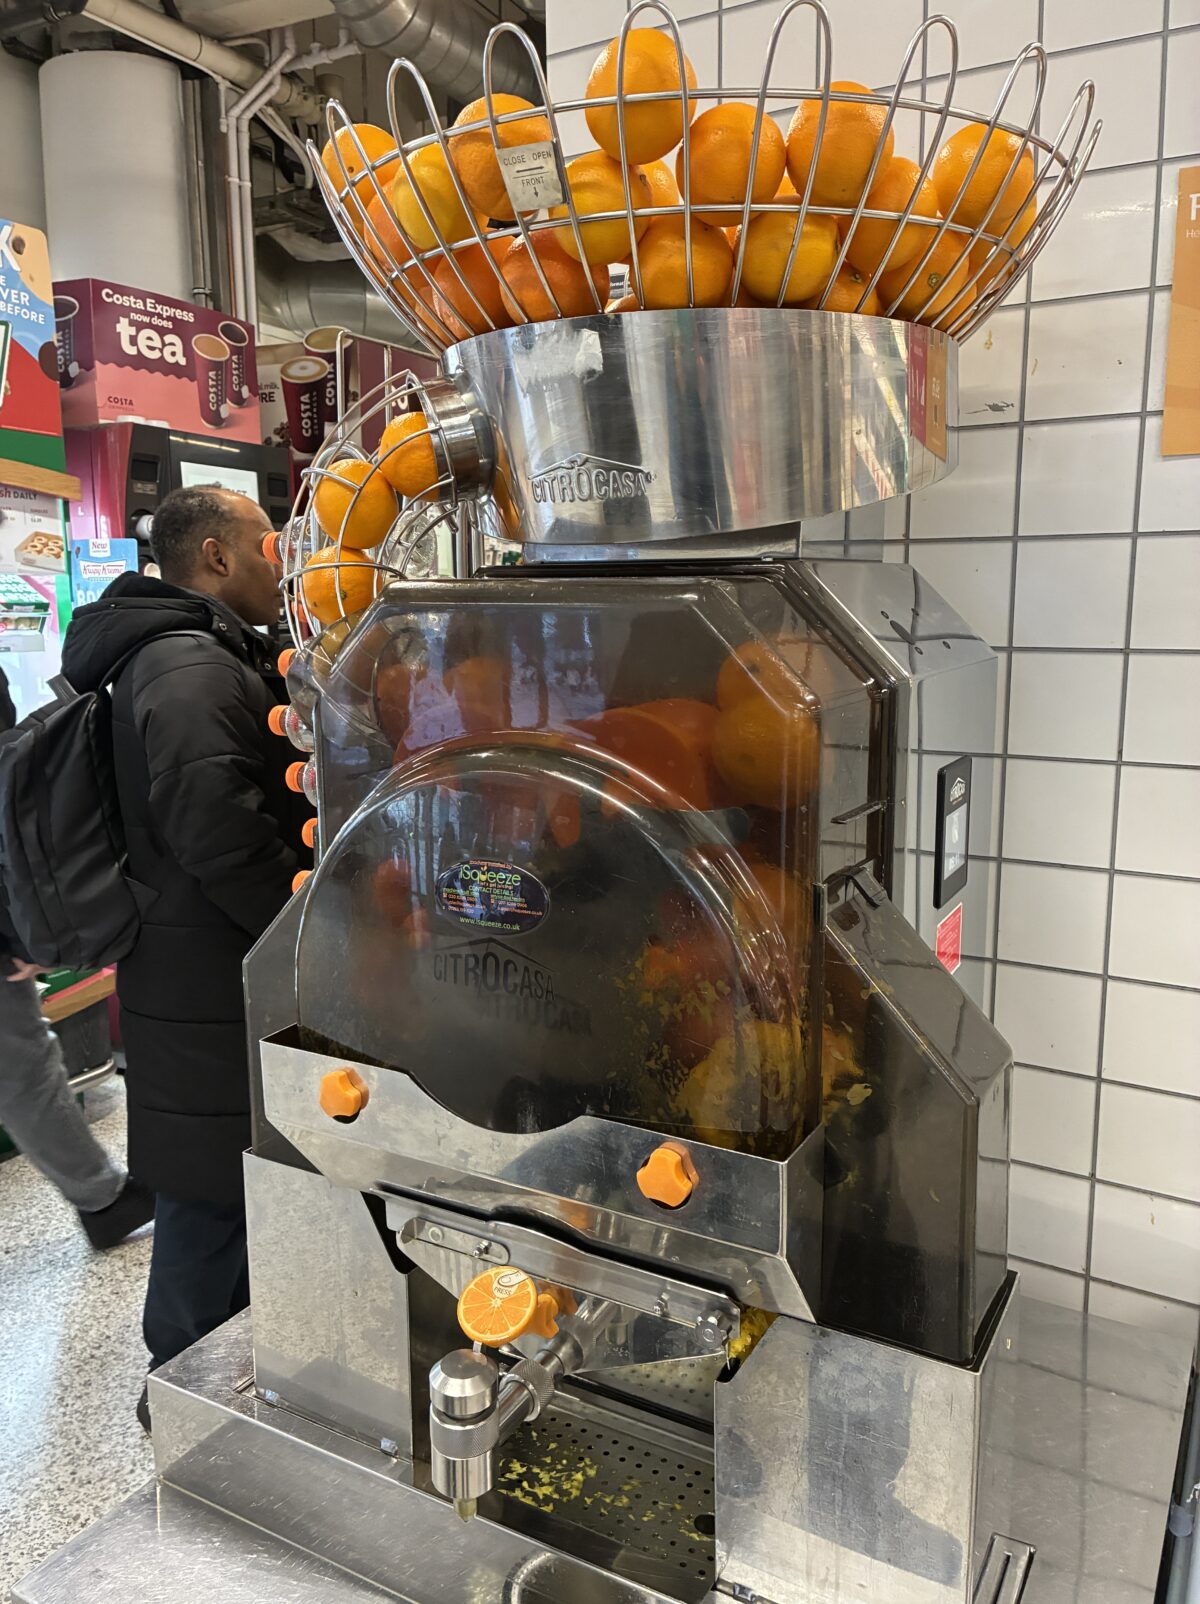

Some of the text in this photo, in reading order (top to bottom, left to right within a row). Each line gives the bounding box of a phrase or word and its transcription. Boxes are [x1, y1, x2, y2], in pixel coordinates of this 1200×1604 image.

[503, 151, 552, 166] CLOSE OPEN
[521, 176, 545, 187] FRONT
[101, 288, 195, 323] Costa Express
[130, 312, 173, 329] now does
[116, 316, 186, 366] tea
[208, 370, 217, 411] COSTA
[107, 396, 134, 406] COSTA
[300, 393, 312, 437] COSTA
[13, 490, 37, 500] DAILY
[91, 541, 107, 550] New
[460, 864, 521, 886] iSqueeze
[459, 916, 521, 931] www.isqueeze.co.uk
[433, 951, 555, 1001] CITROCASA
[494, 1286, 512, 1296] PRESS
